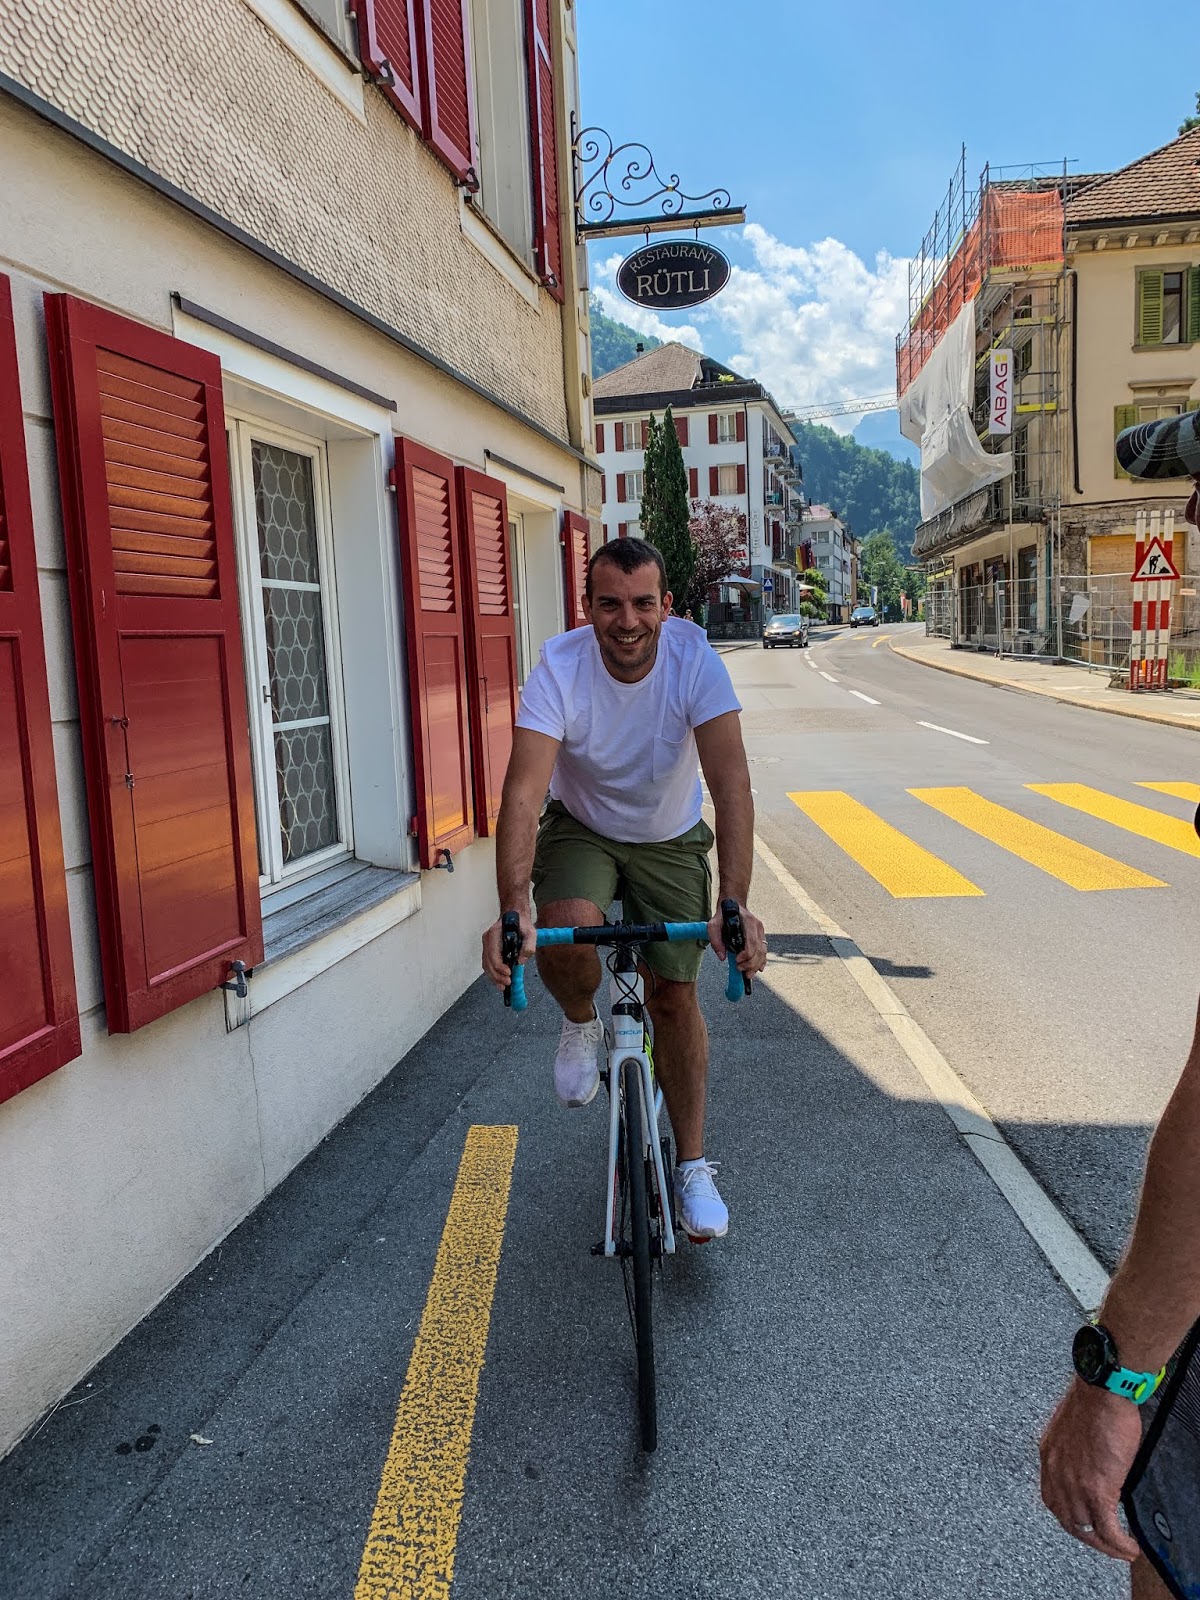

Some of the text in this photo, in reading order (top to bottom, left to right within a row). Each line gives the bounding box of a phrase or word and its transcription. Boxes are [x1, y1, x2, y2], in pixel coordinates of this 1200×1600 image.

[629, 245, 717, 273] RESTAURANT
[636, 268, 710, 297] RÜTLI
[994, 363, 1008, 427] ABAG
[751, 510, 760, 558] HOTEL
